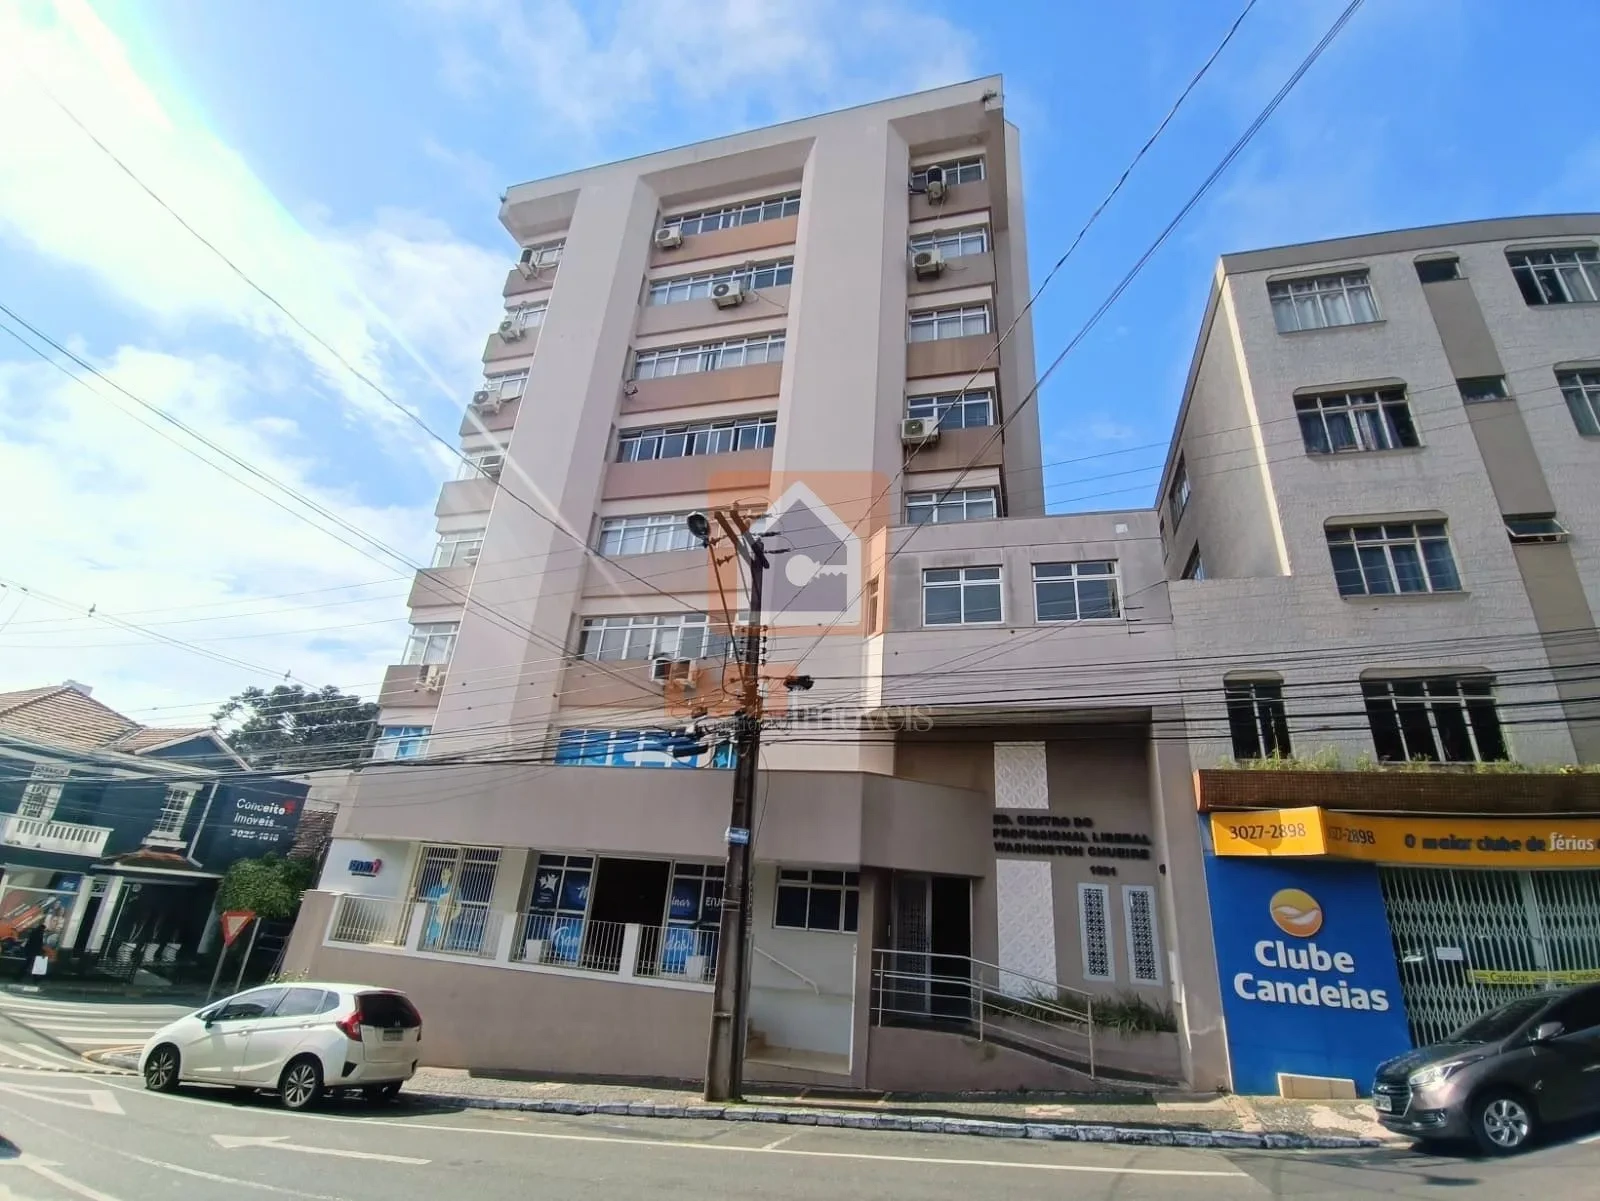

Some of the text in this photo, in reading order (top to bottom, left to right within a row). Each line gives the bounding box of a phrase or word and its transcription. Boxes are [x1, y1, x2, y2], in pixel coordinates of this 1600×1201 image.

[236, 798, 286, 816] Conceito
[233, 812, 276, 828] Imóveis
[1017, 815, 1071, 827] CENTRO
[1073, 817, 1094, 828] DO
[993, 828, 1153, 846] PROFISSIONAL LIBERAL
[1229, 823, 1307, 845] 3027-2898
[1404, 833, 1416, 848] O
[1549, 832, 1595, 852] férias
[994, 842, 1084, 857] WASHINGTON
[1254, 939, 1355, 974] Clube
[1233, 972, 1390, 1012] Candeias
